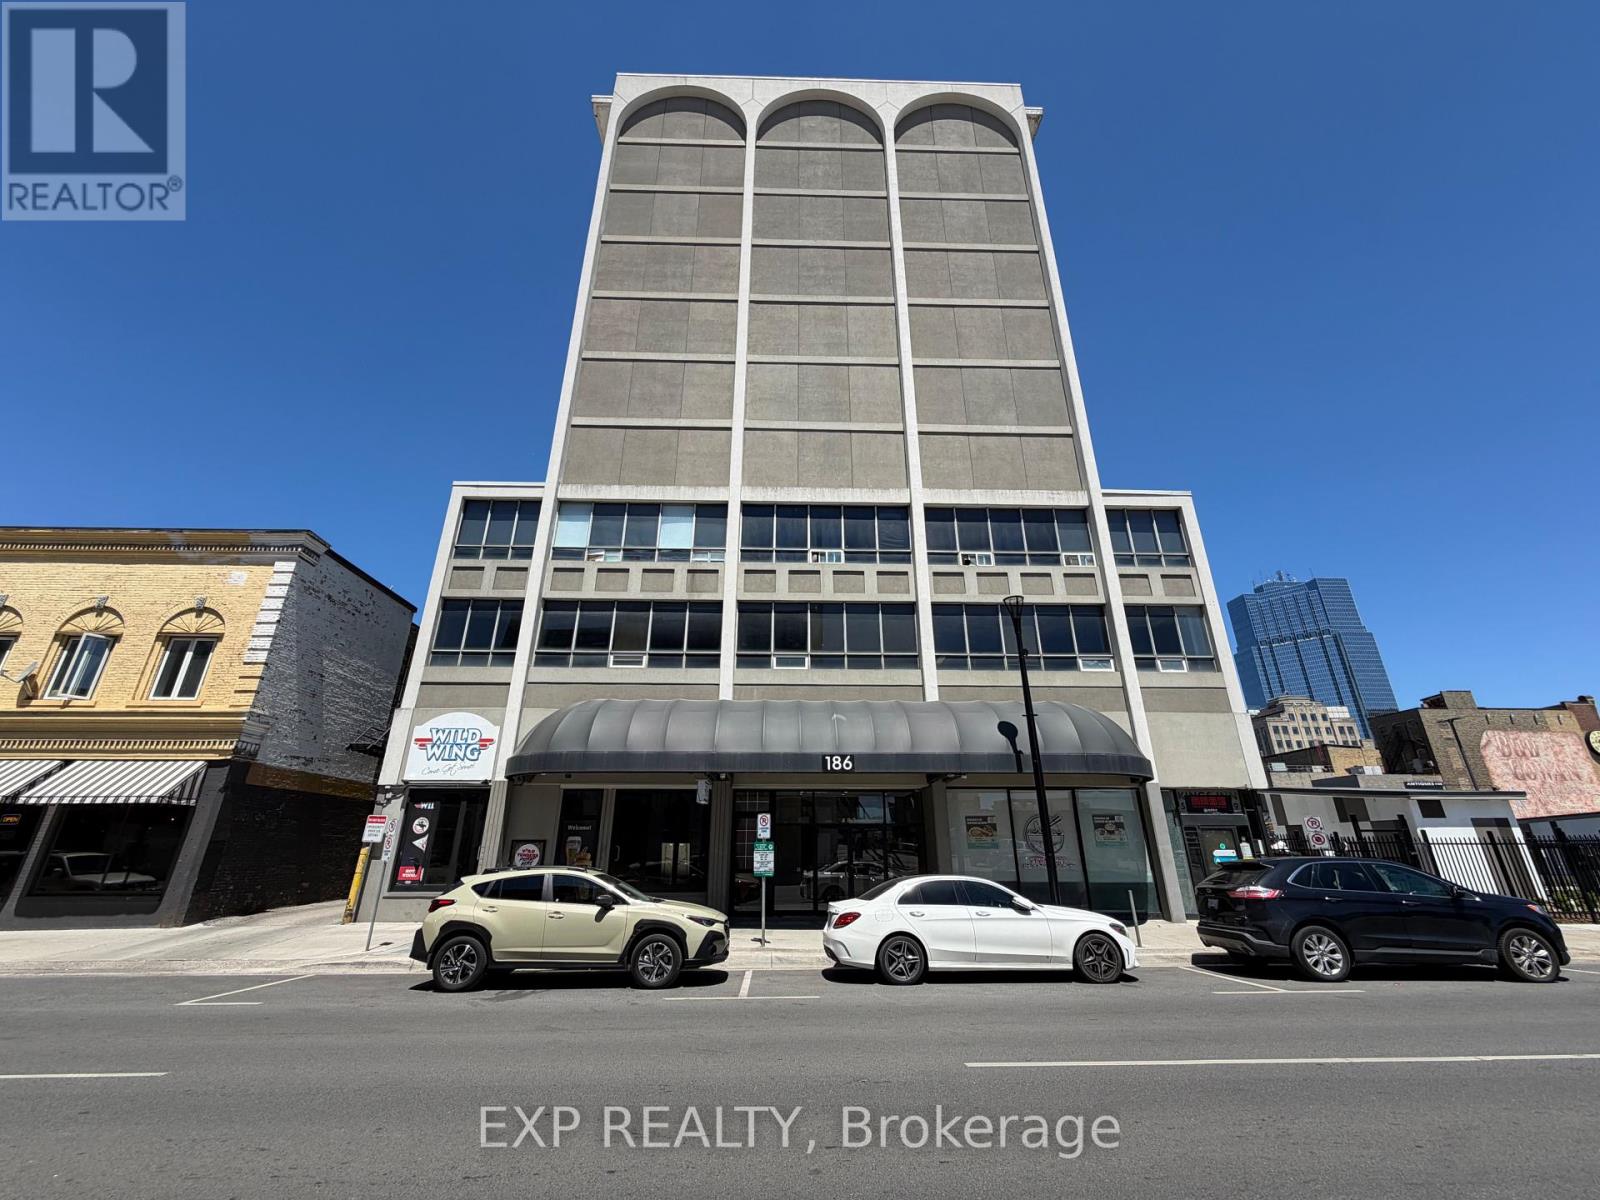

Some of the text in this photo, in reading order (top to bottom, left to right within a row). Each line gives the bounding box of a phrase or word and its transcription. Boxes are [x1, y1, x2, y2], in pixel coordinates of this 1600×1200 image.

[429, 727, 483, 745] WILD
[425, 743, 482, 761] WING
[824, 755, 853, 771] 186
